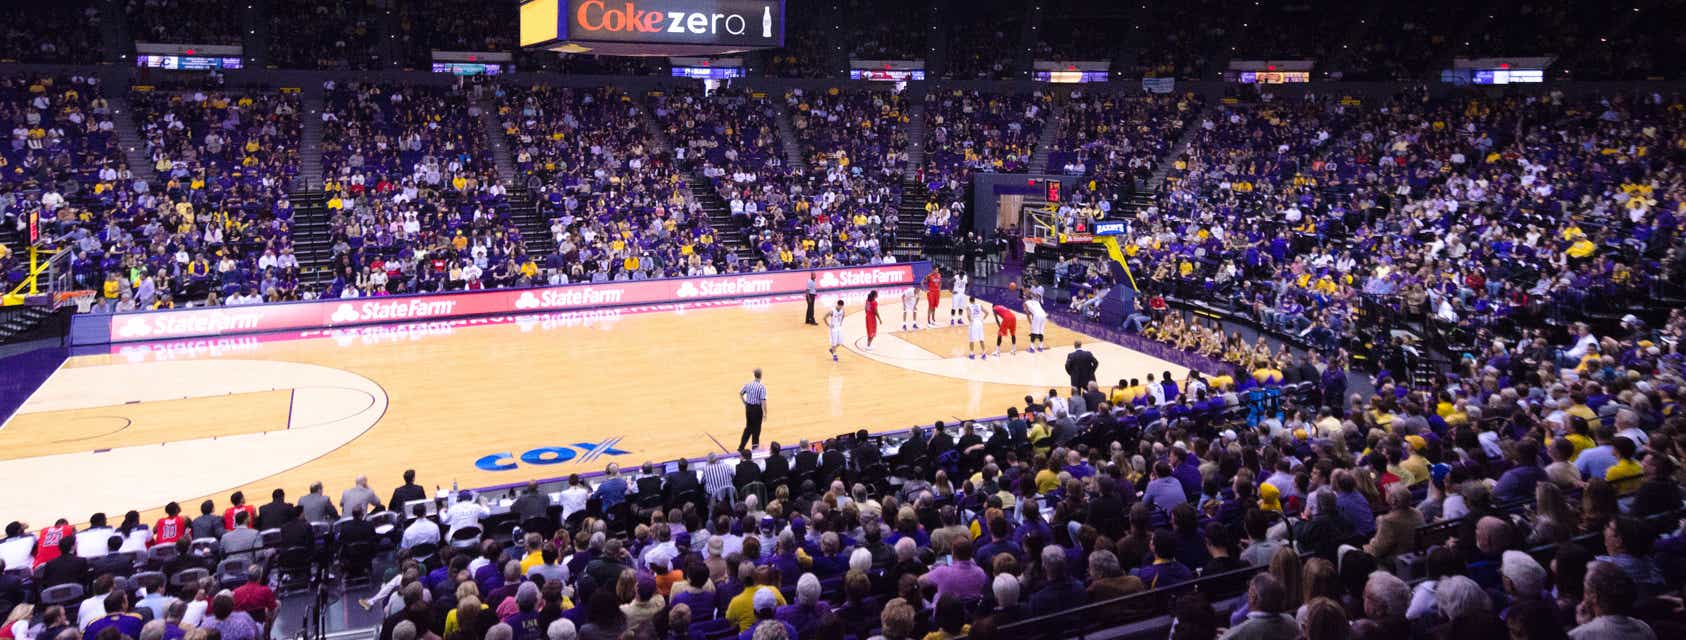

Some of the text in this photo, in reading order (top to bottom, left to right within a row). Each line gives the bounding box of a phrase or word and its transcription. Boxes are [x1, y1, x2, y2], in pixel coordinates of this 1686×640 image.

[577, 0, 745, 35] Coke zero
[474, 435, 633, 471] COX
